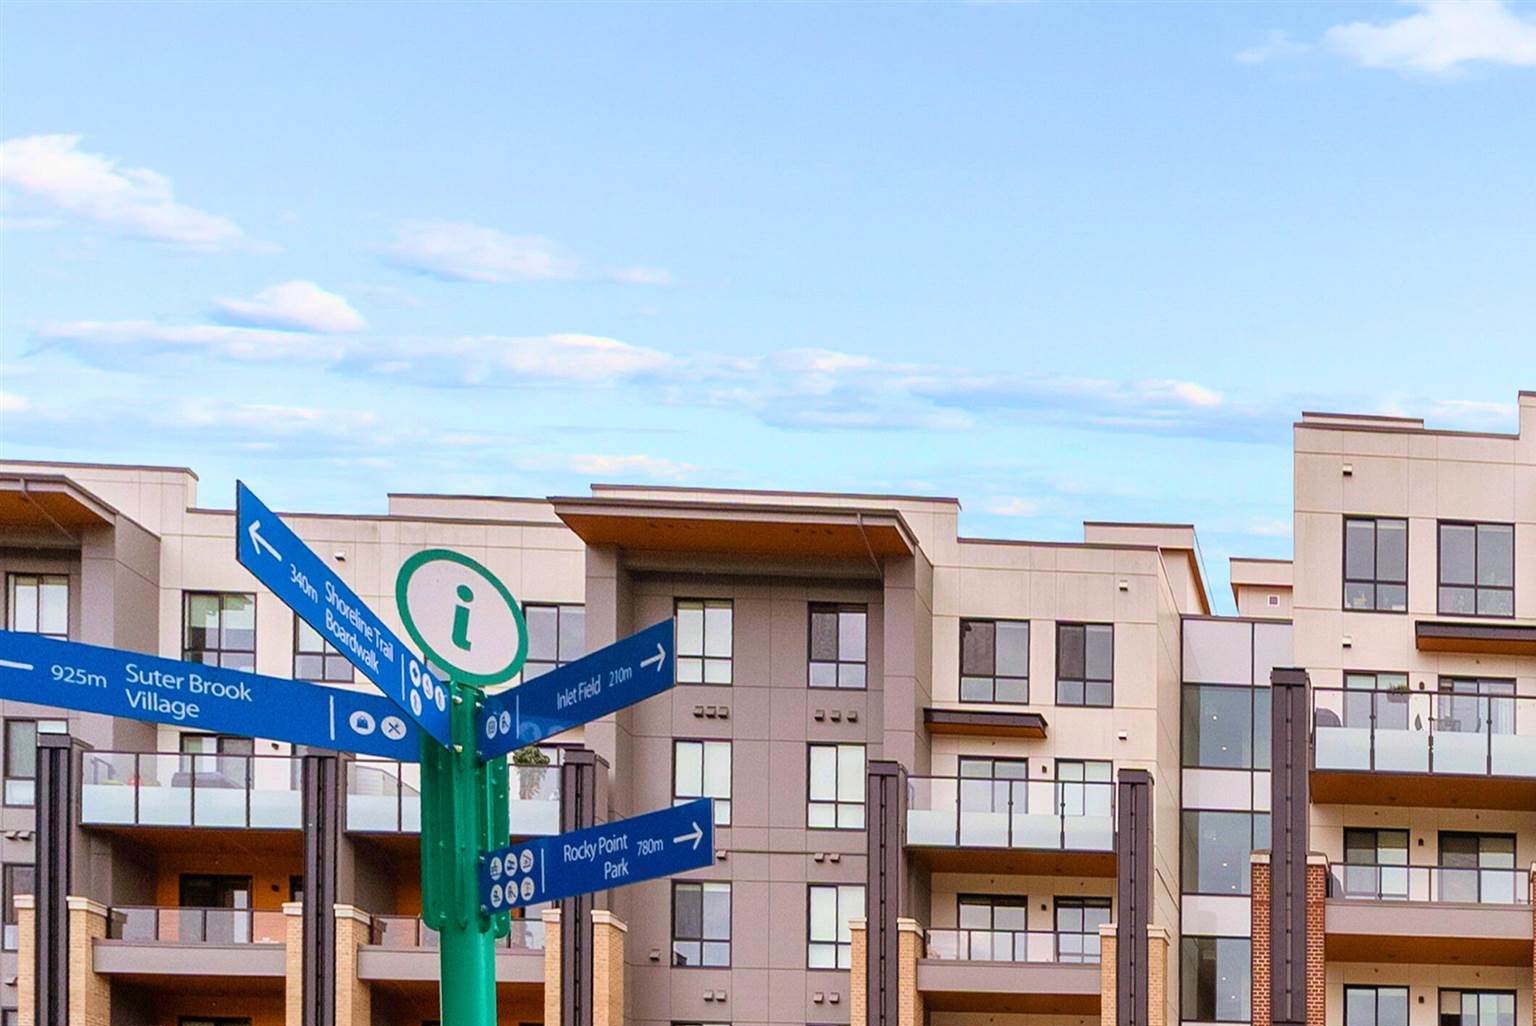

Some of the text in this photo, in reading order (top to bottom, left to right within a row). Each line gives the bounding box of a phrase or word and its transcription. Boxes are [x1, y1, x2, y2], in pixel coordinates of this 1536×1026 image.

[290, 564, 318, 603] 340m
[325, 580, 394, 662] Shoreline Trail
[325, 608, 380, 675] Boardwalk
[51, 664, 107, 688] 925m
[125, 663, 252, 702] Suter Brook
[557, 666, 633, 711] Inlet Field 210m
[125, 688, 200, 720] Village
[563, 834, 628, 863] Rocky Point
[636, 838, 663, 857] 780m
[604, 857, 629, 880] Park
